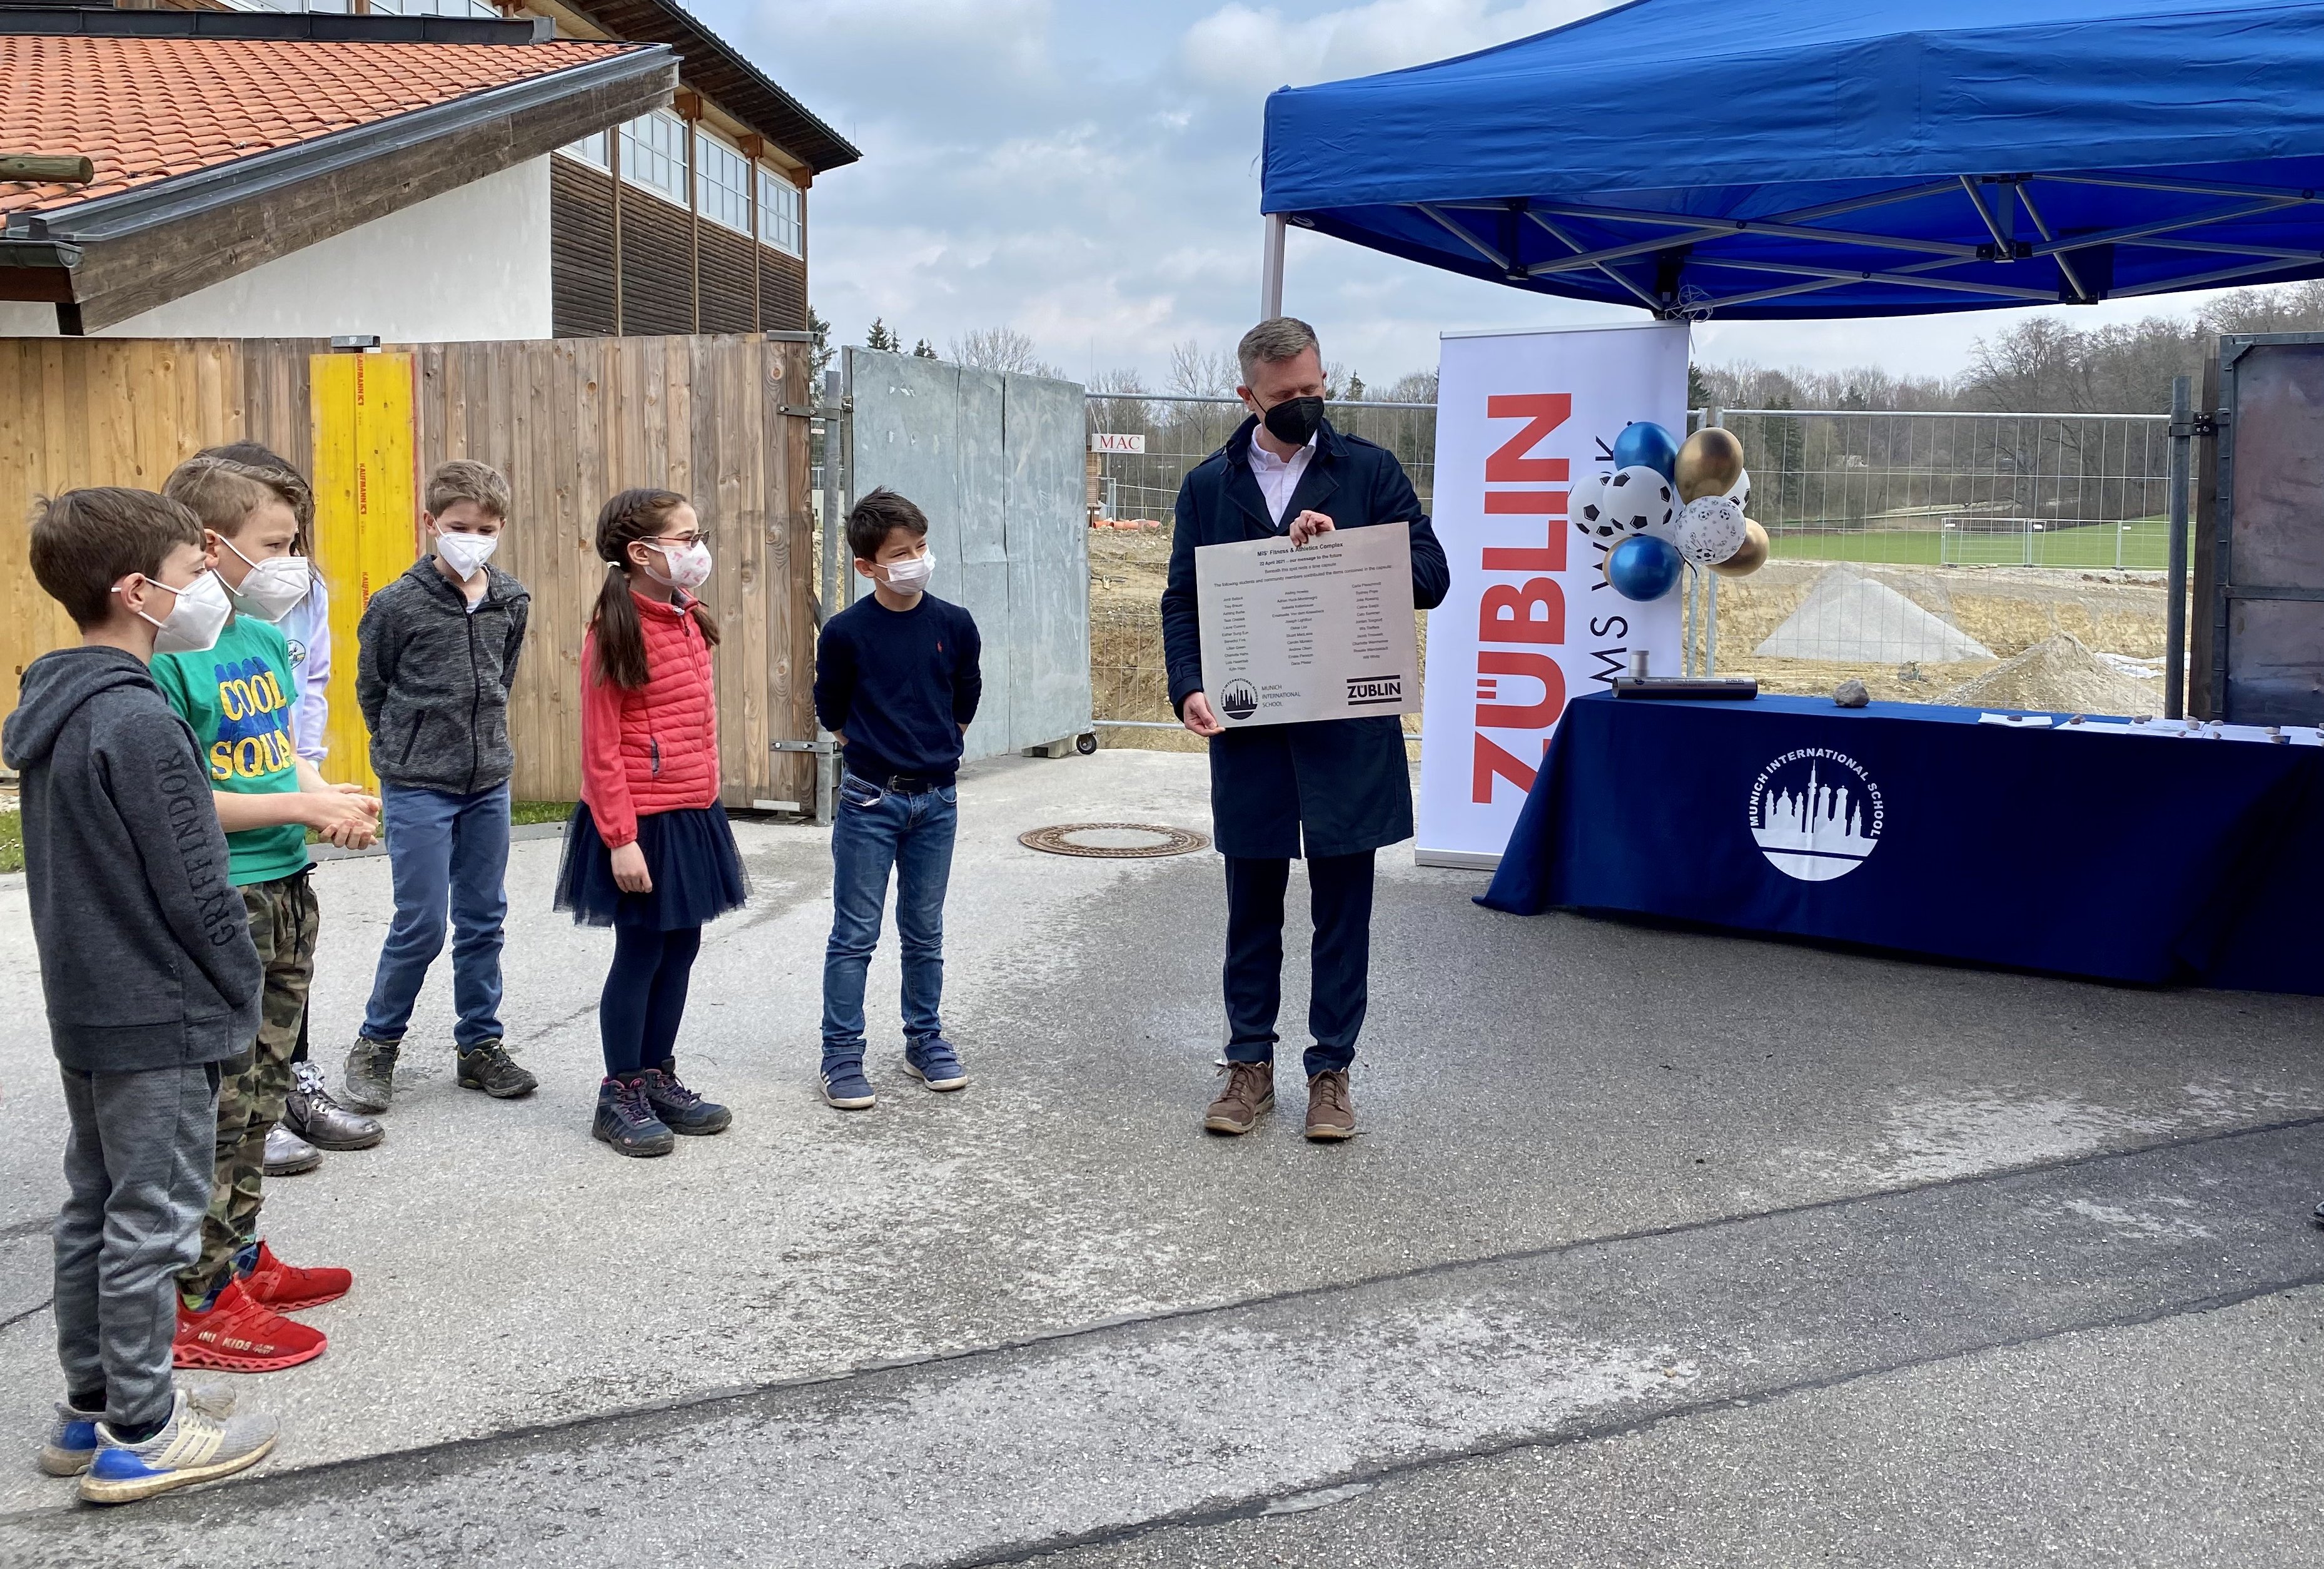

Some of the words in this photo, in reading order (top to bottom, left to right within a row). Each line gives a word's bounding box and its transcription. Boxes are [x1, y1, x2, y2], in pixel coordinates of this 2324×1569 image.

[1099, 435, 1140, 450] MAC
[1320, 542, 1343, 551] Complex
[1472, 393, 1572, 804] ZÜBLIN
[219, 671, 287, 721] COOL
[1347, 682, 1401, 698] ZÜBLIN
[210, 729, 295, 780] SQUA
[1749, 773, 1769, 826] MUNICH
[1766, 748, 1869, 781] INTERNATIONAL
[1867, 783, 1884, 836] SCHOOL
[158, 746, 236, 947] GRYFFINDOR
[222, 1338, 252, 1351] KIDS
